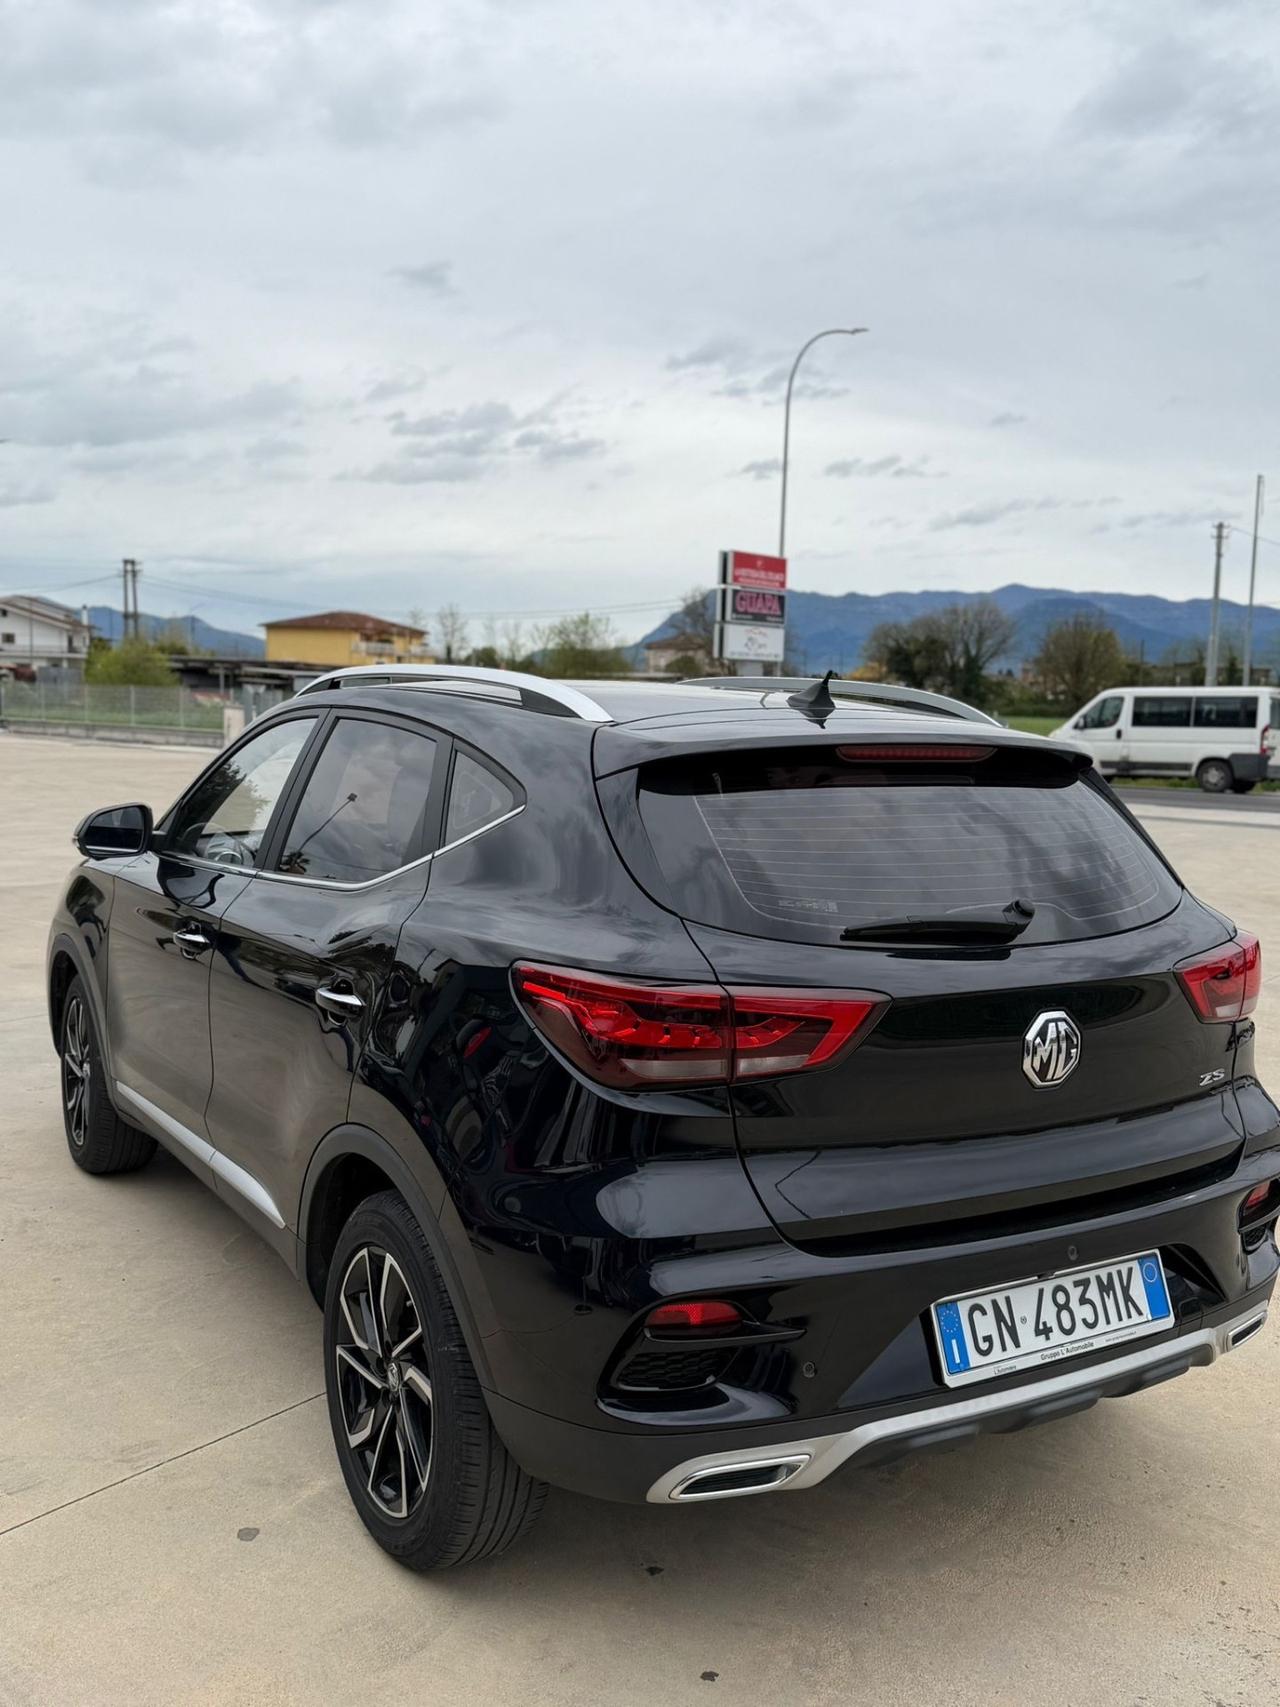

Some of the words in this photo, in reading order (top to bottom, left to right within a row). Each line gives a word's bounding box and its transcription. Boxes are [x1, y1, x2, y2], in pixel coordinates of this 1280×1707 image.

[736, 592, 782, 615] GUAPA
[1033, 1022, 1077, 1080] MG
[1199, 1069, 1226, 1086] ZS
[968, 1295, 1021, 1357] GN
[1034, 1266, 1144, 1341] 483MK
[1041, 1349, 1060, 1361] Gruppo
[1061, 1341, 1094, 1356] L'Automobile
